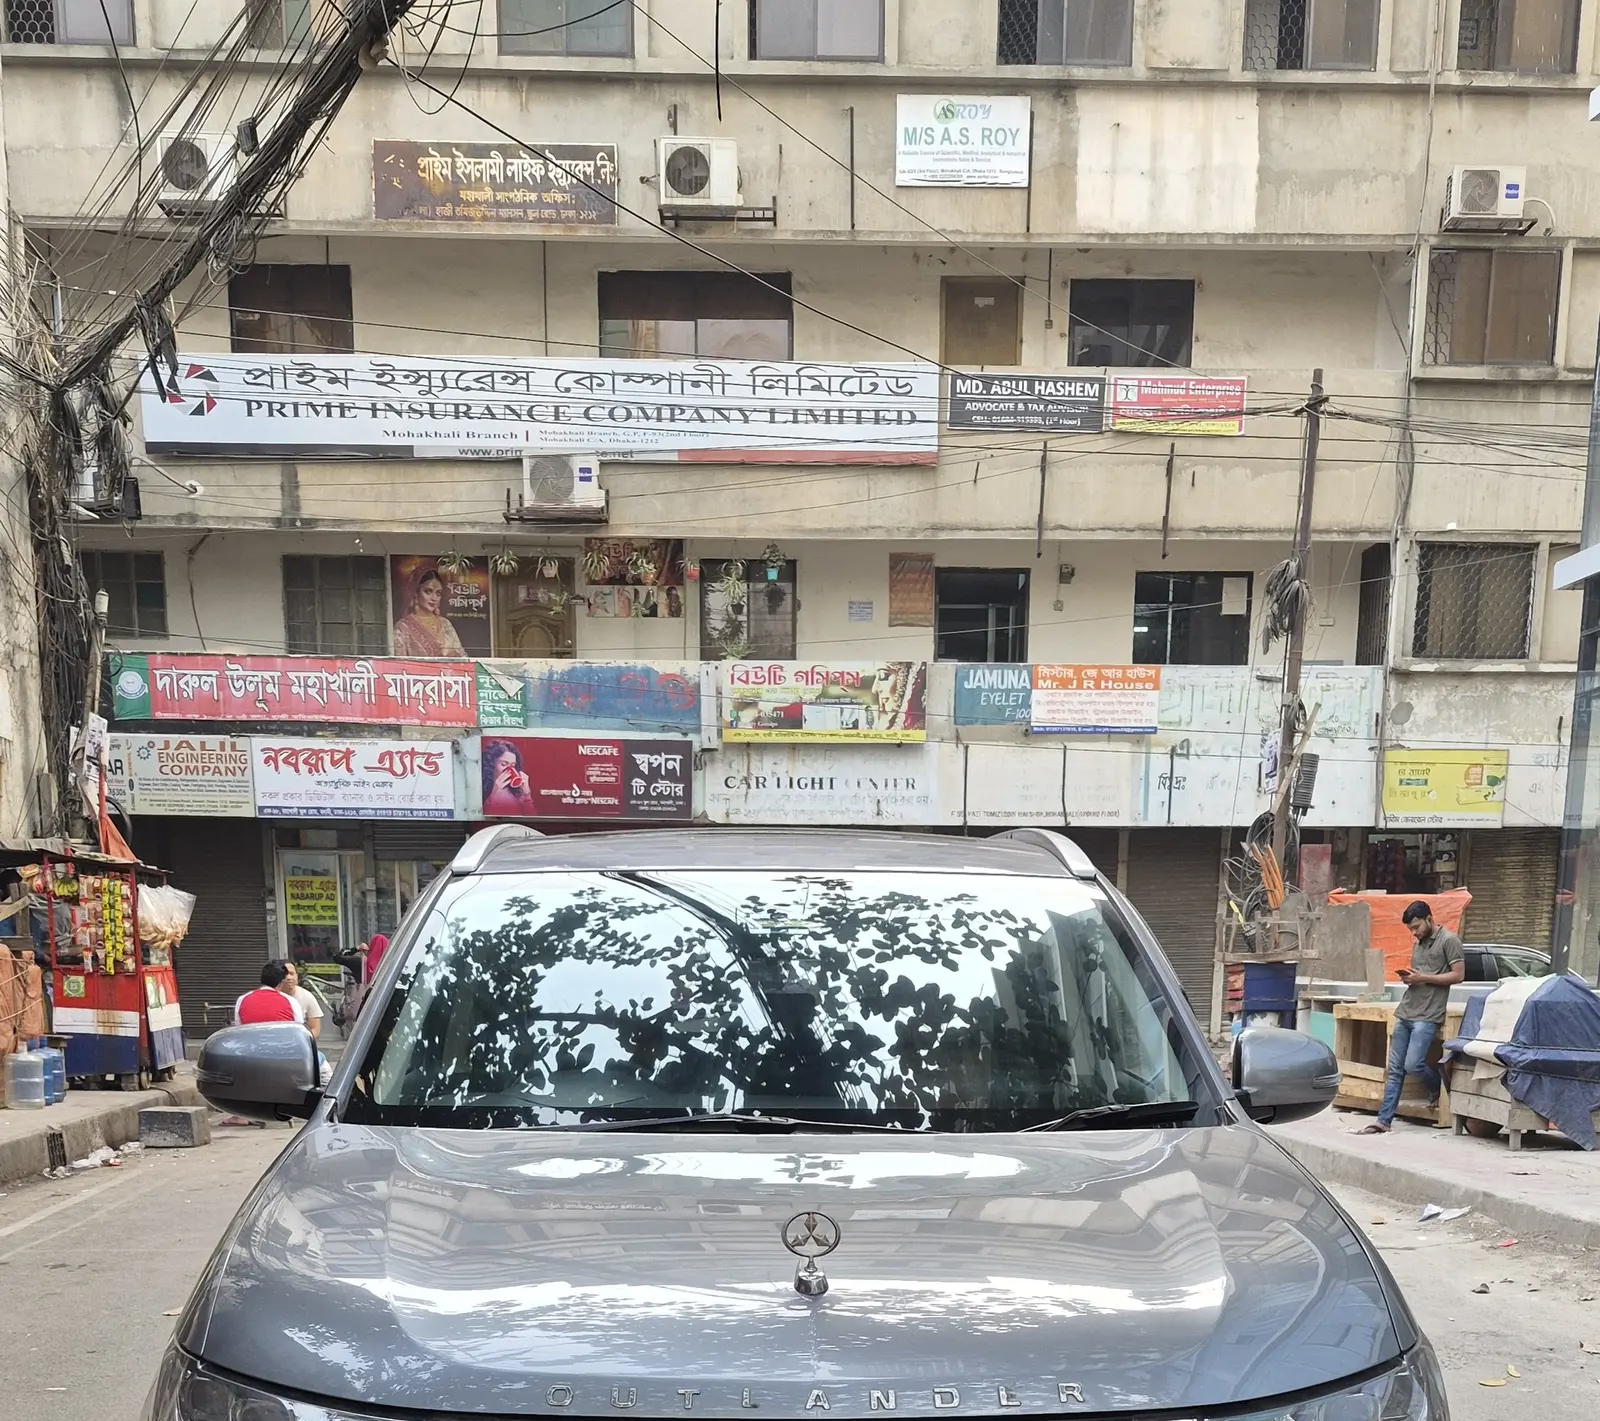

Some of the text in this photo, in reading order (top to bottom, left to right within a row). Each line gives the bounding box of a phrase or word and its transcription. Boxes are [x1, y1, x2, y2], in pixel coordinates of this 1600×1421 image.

[903, 126, 1021, 147] M/S A.S. ROY
[417, 147, 452, 184] প্রাইম
[454, 147, 505, 184] ইসলামী
[506, 150, 545, 185] লাইফ
[495, 189, 538, 205] সাংগঠনিক
[242, 358, 357, 392] প্রাইম
[554, 363, 732, 397] কোম্পানী
[746, 365, 919, 398] লিমিটেড
[955, 379, 1100, 398] MD. ABUL HASHEM
[1140, 380, 1242, 398] Mahmud Enterprise
[244, 400, 918, 426] PRIME INSURANCE COMPANY LIMITED
[964, 402, 1015, 412] ADVOCATE
[1027, 403, 1045, 412] TAX
[381, 429, 518, 440] Mohakhali Branch
[729, 664, 787, 686] বিউটি
[963, 668, 1031, 690] JAMUNA
[1081, 668, 1098, 680] জে
[1101, 668, 1122, 680] আর
[1126, 666, 1156, 680] হাউস
[152, 665, 220, 702] দারুল
[286, 660, 379, 708] মহাখালী
[1037, 680, 1155, 690] Mr. J R House
[980, 691, 1024, 706] EYELET
[156, 738, 248, 753] JALIL
[158, 752, 248, 765] ENGINEERING
[260, 746, 357, 775] নবরূপ
[631, 751, 684, 777] স্বপন
[158, 764, 248, 778] COMPANY
[630, 777, 686, 798] টি স্টোর
[723, 776, 768, 790] CAR
[290, 892, 336, 900] NABARUP AD
[545, 1381, 1085, 1410] OUTLANDER
